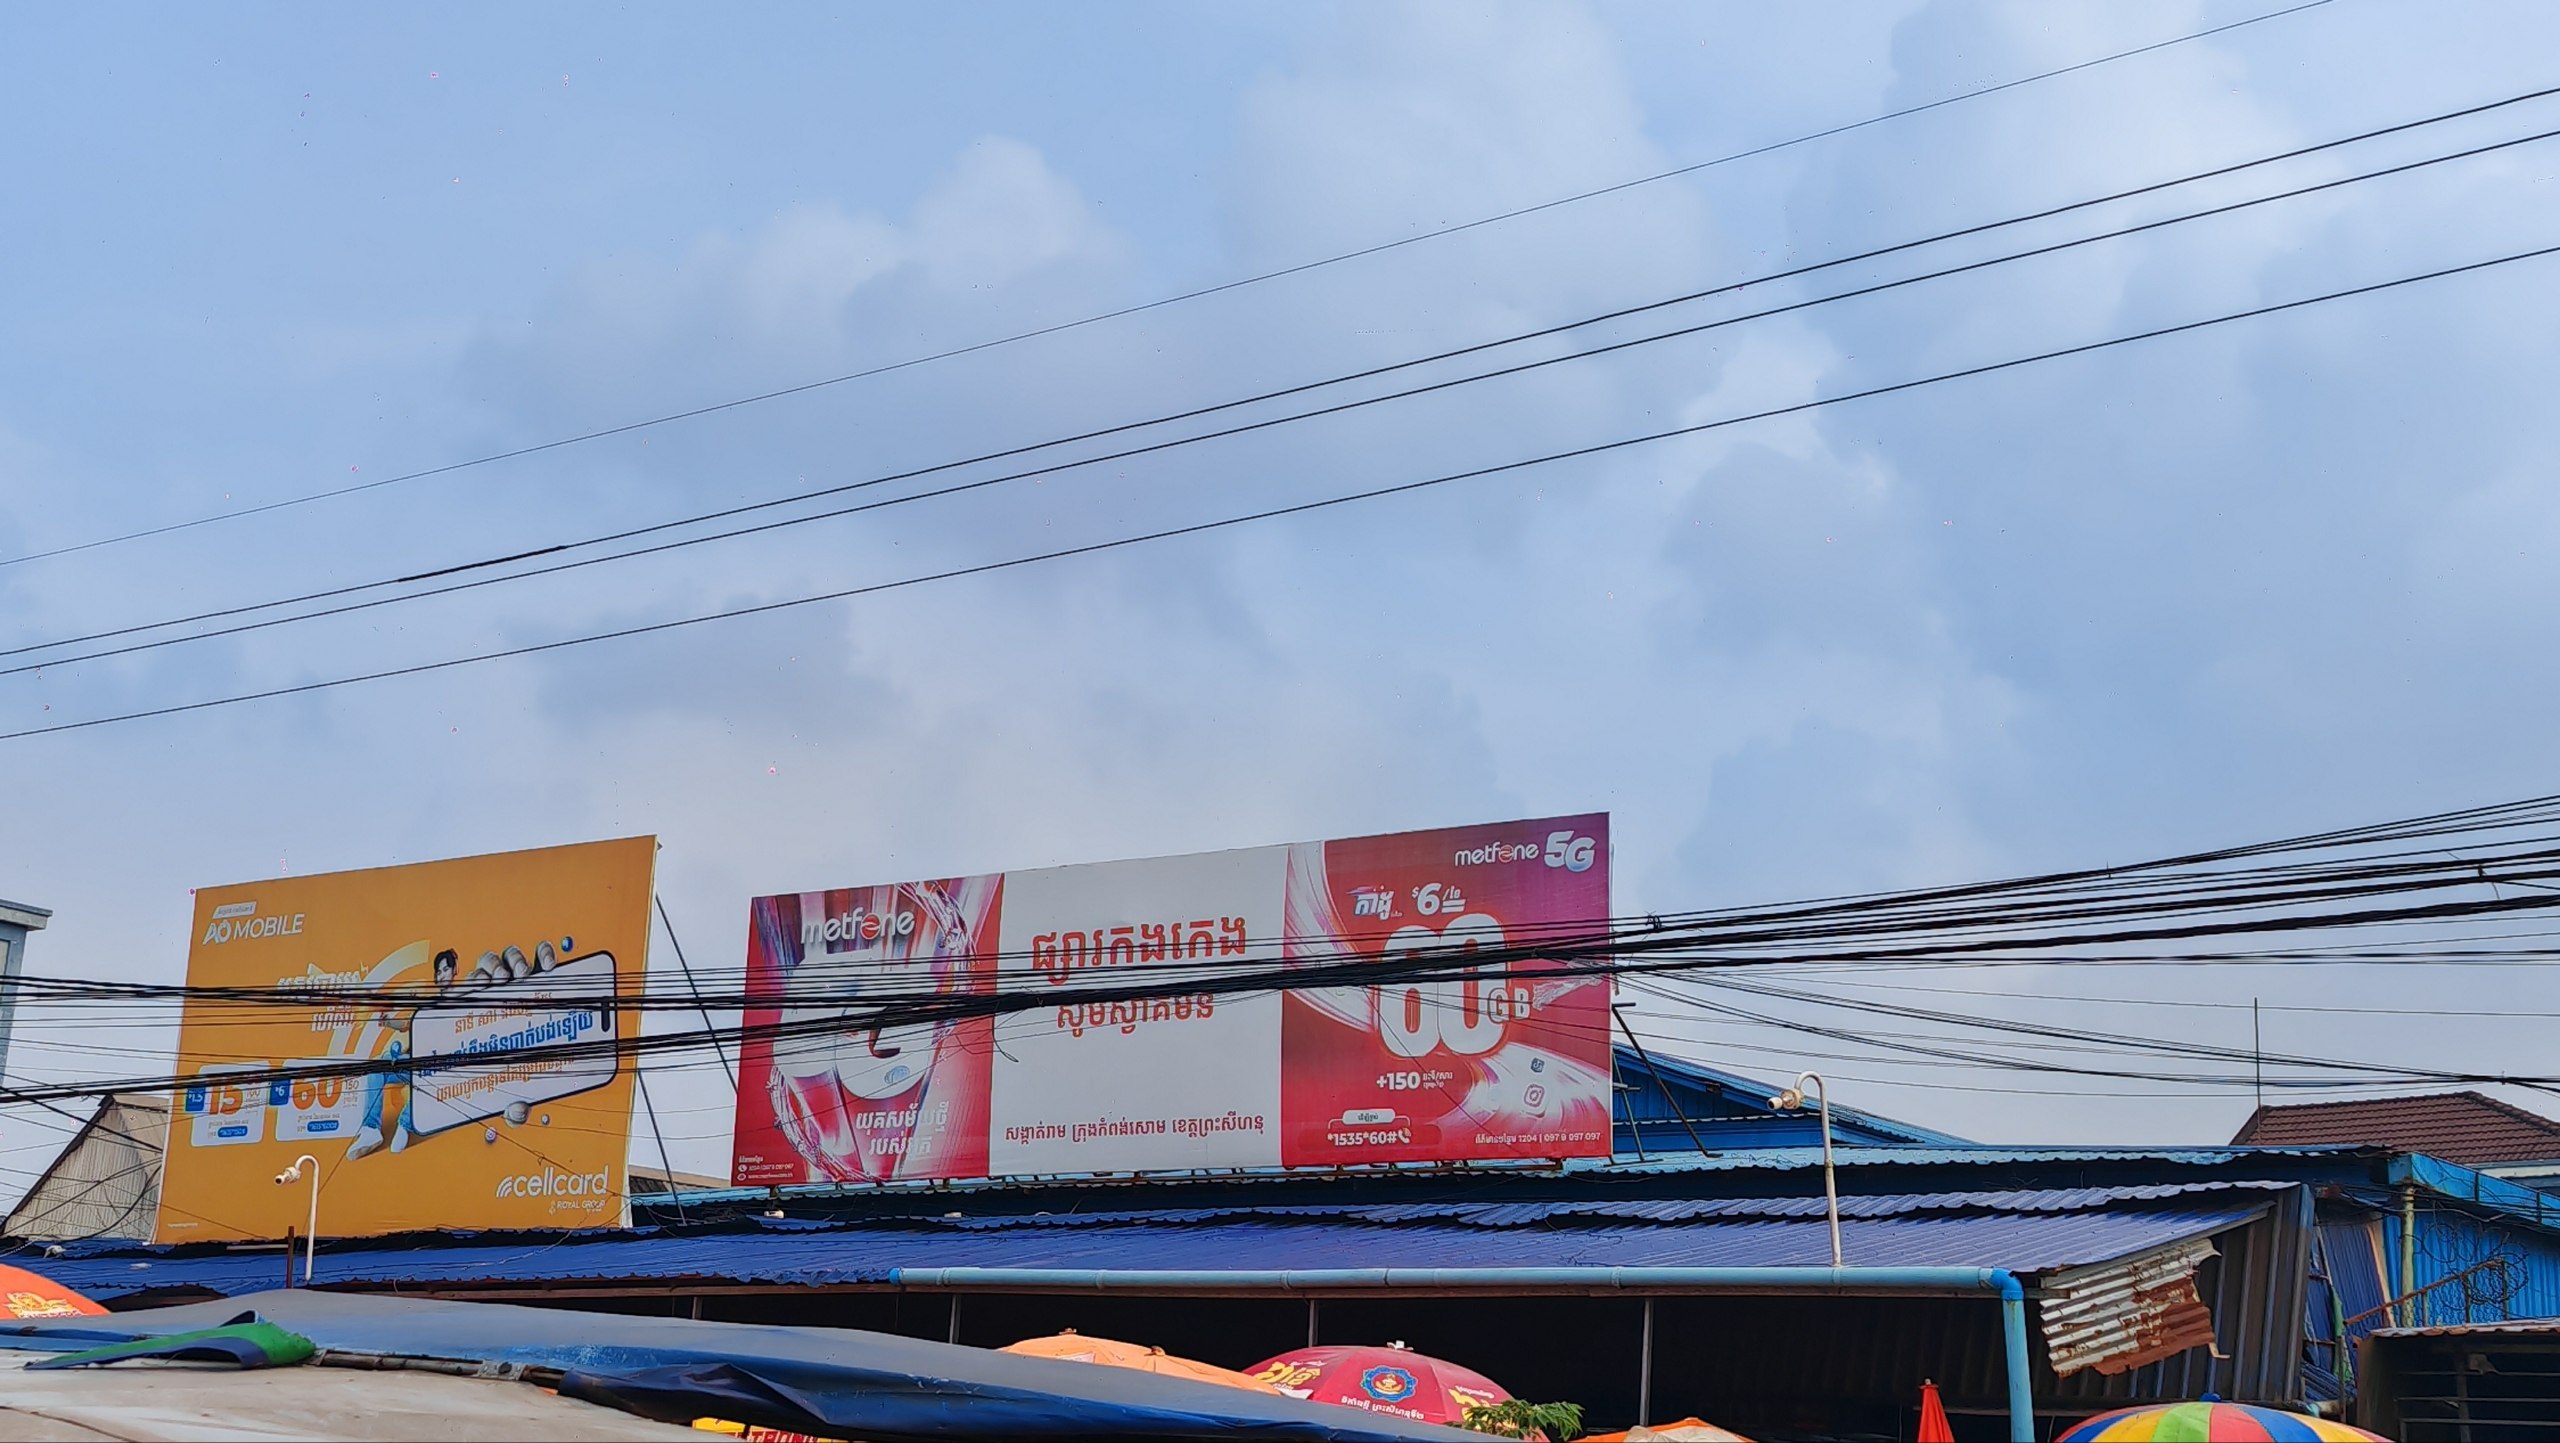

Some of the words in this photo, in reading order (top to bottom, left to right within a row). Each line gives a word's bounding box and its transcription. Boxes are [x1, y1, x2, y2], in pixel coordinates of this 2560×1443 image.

[1454, 842, 1539, 867] metfone
[1544, 830, 1597, 872] 5G
[233, 913, 305, 940] MOBILE
[800, 907, 915, 944] metfone
[1056, 991, 1215, 1038] សូមស្វាគមន
[1487, 986, 1532, 1024] GB
[1376, 1071, 1421, 1090] +150
[1005, 1120, 1067, 1145] សង្កាត់រាម
[1072, 1117, 1167, 1143] ក្រុងកំពង់សោម
[1518, 1134, 1537, 1143] 1204
[1544, 1133, 1559, 1142] 097
[1584, 1131, 1601, 1142] 097
[513, 1165, 609, 1197] cellcard
[556, 1200, 580, 1209] ROYAL
[581, 1199, 606, 1209] GROUP
